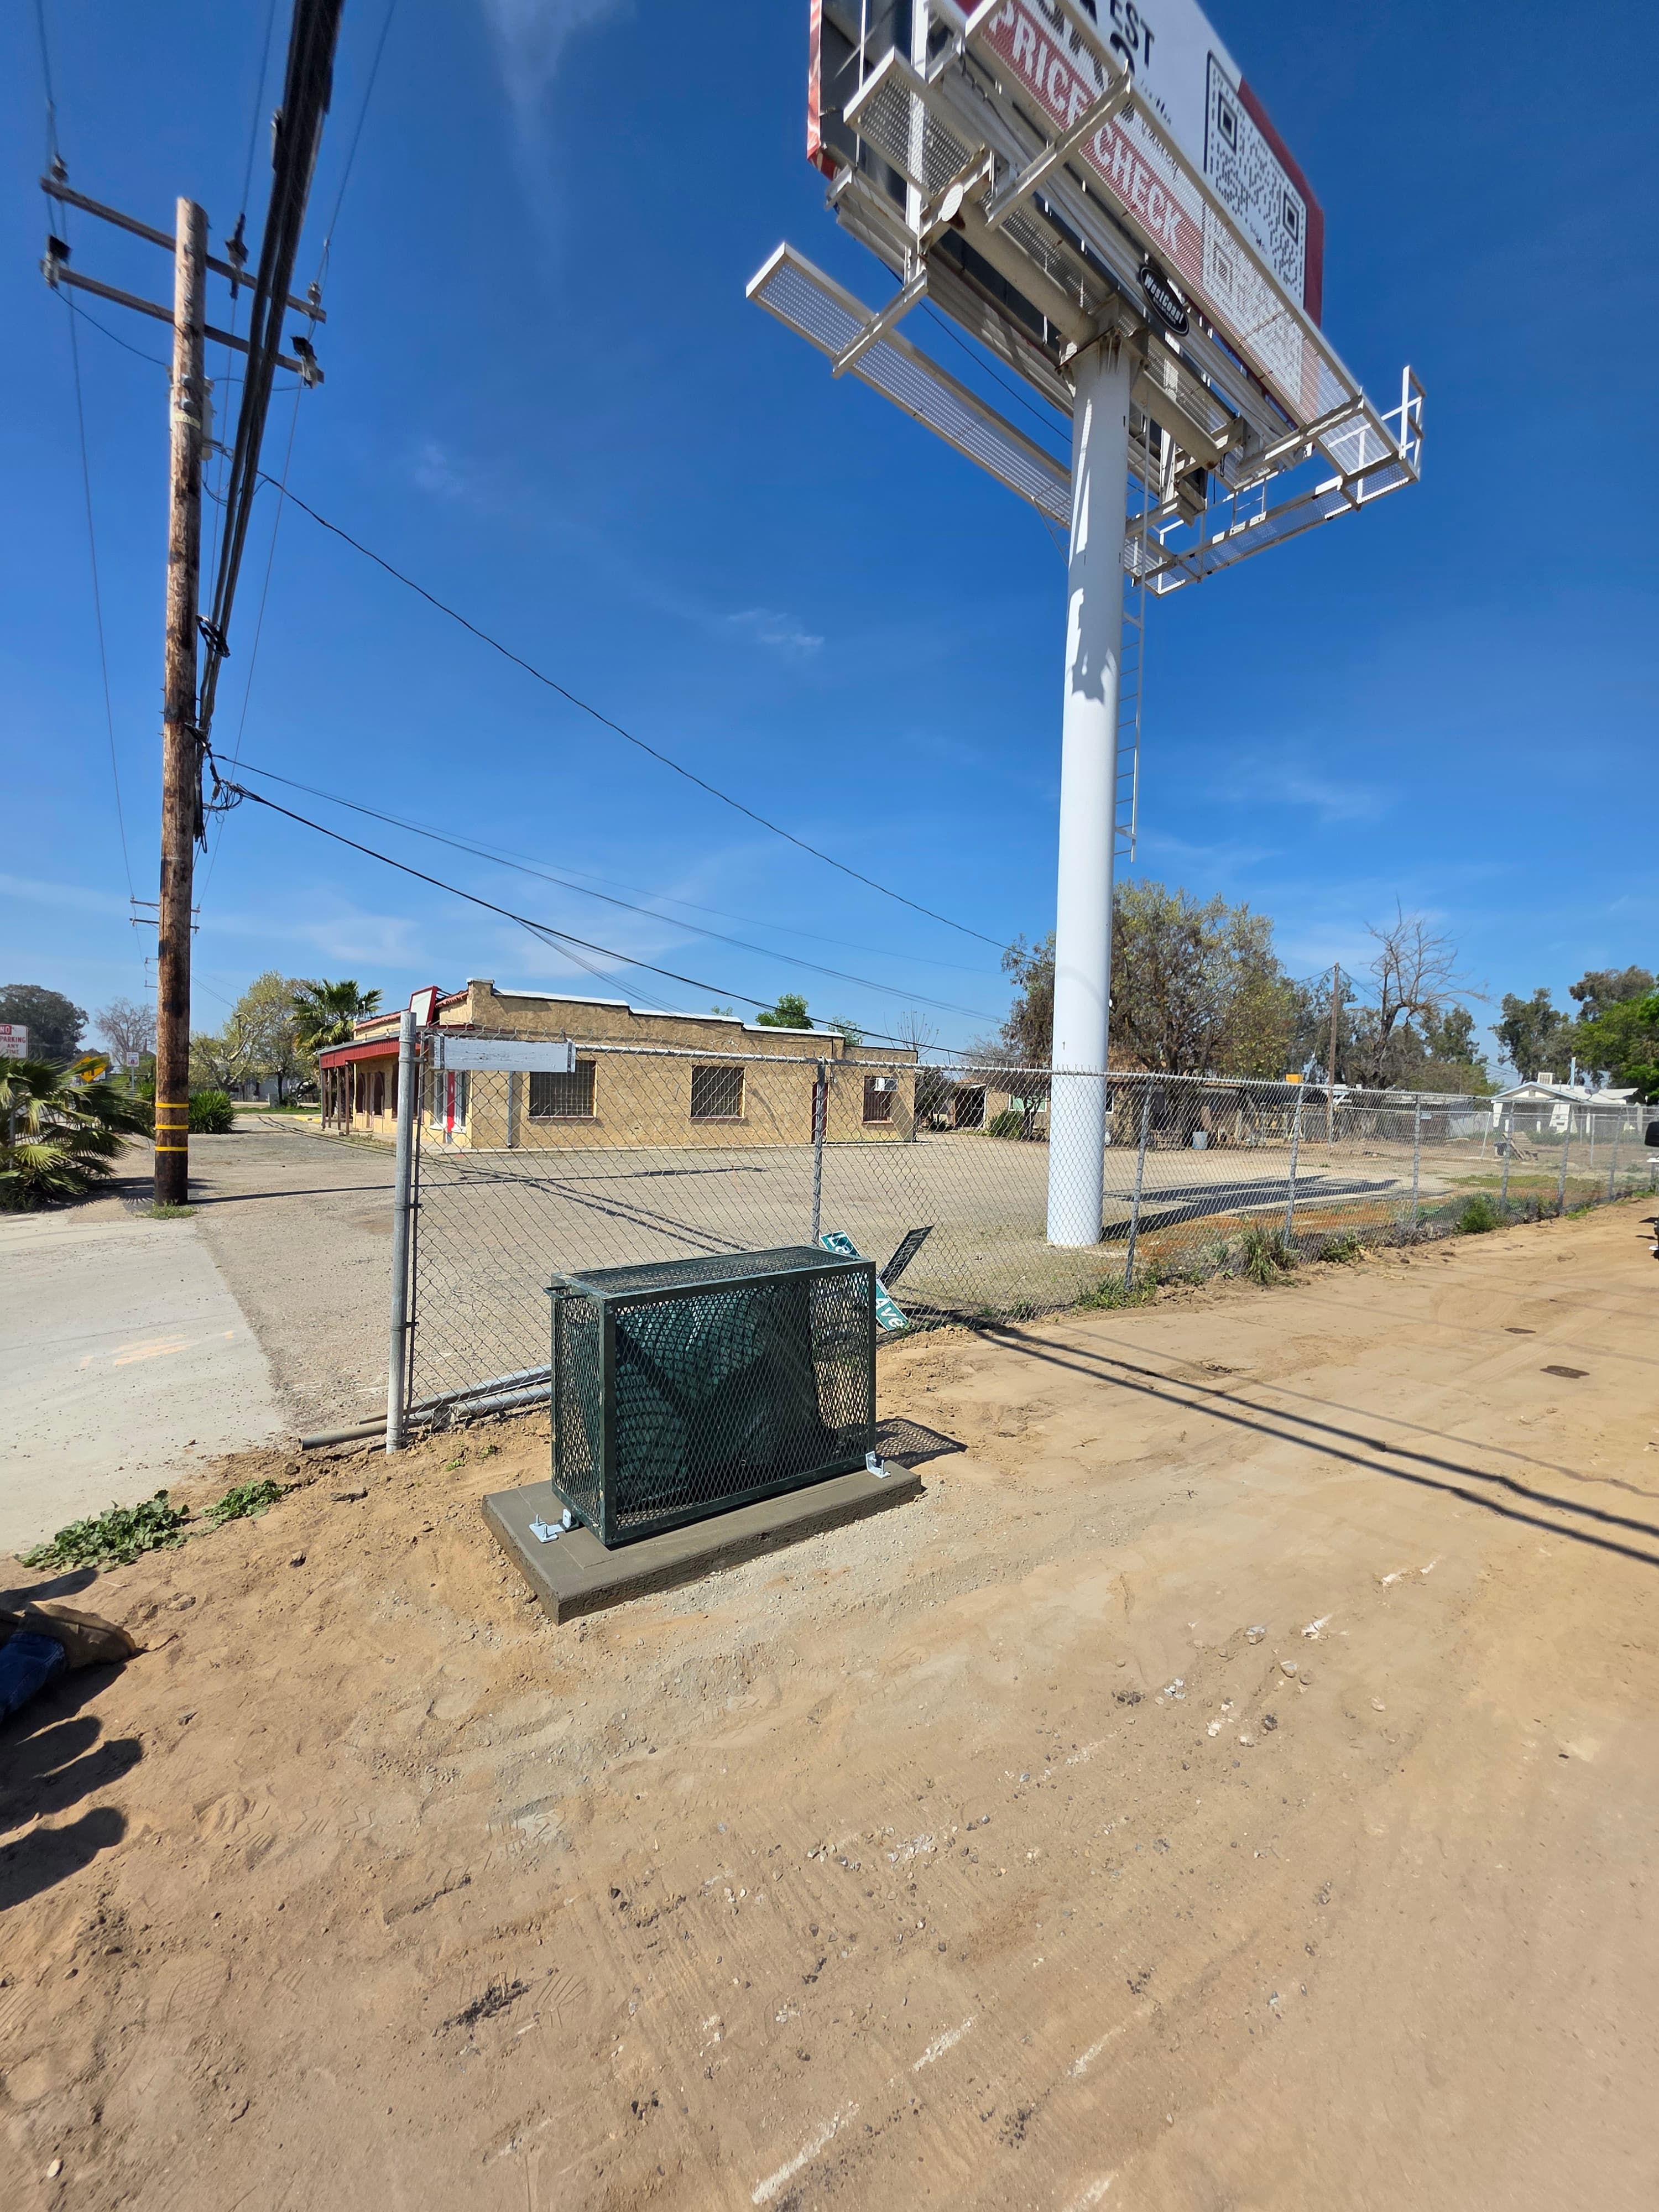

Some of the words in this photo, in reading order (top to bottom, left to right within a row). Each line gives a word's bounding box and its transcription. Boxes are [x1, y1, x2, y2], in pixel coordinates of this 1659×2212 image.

[1094, 123, 1182, 253] CHECK
[1144, 274, 1184, 325] WestCoast
[0, 1026, 10, 1034] NO
[876, 1298, 905, 1328] Ave
